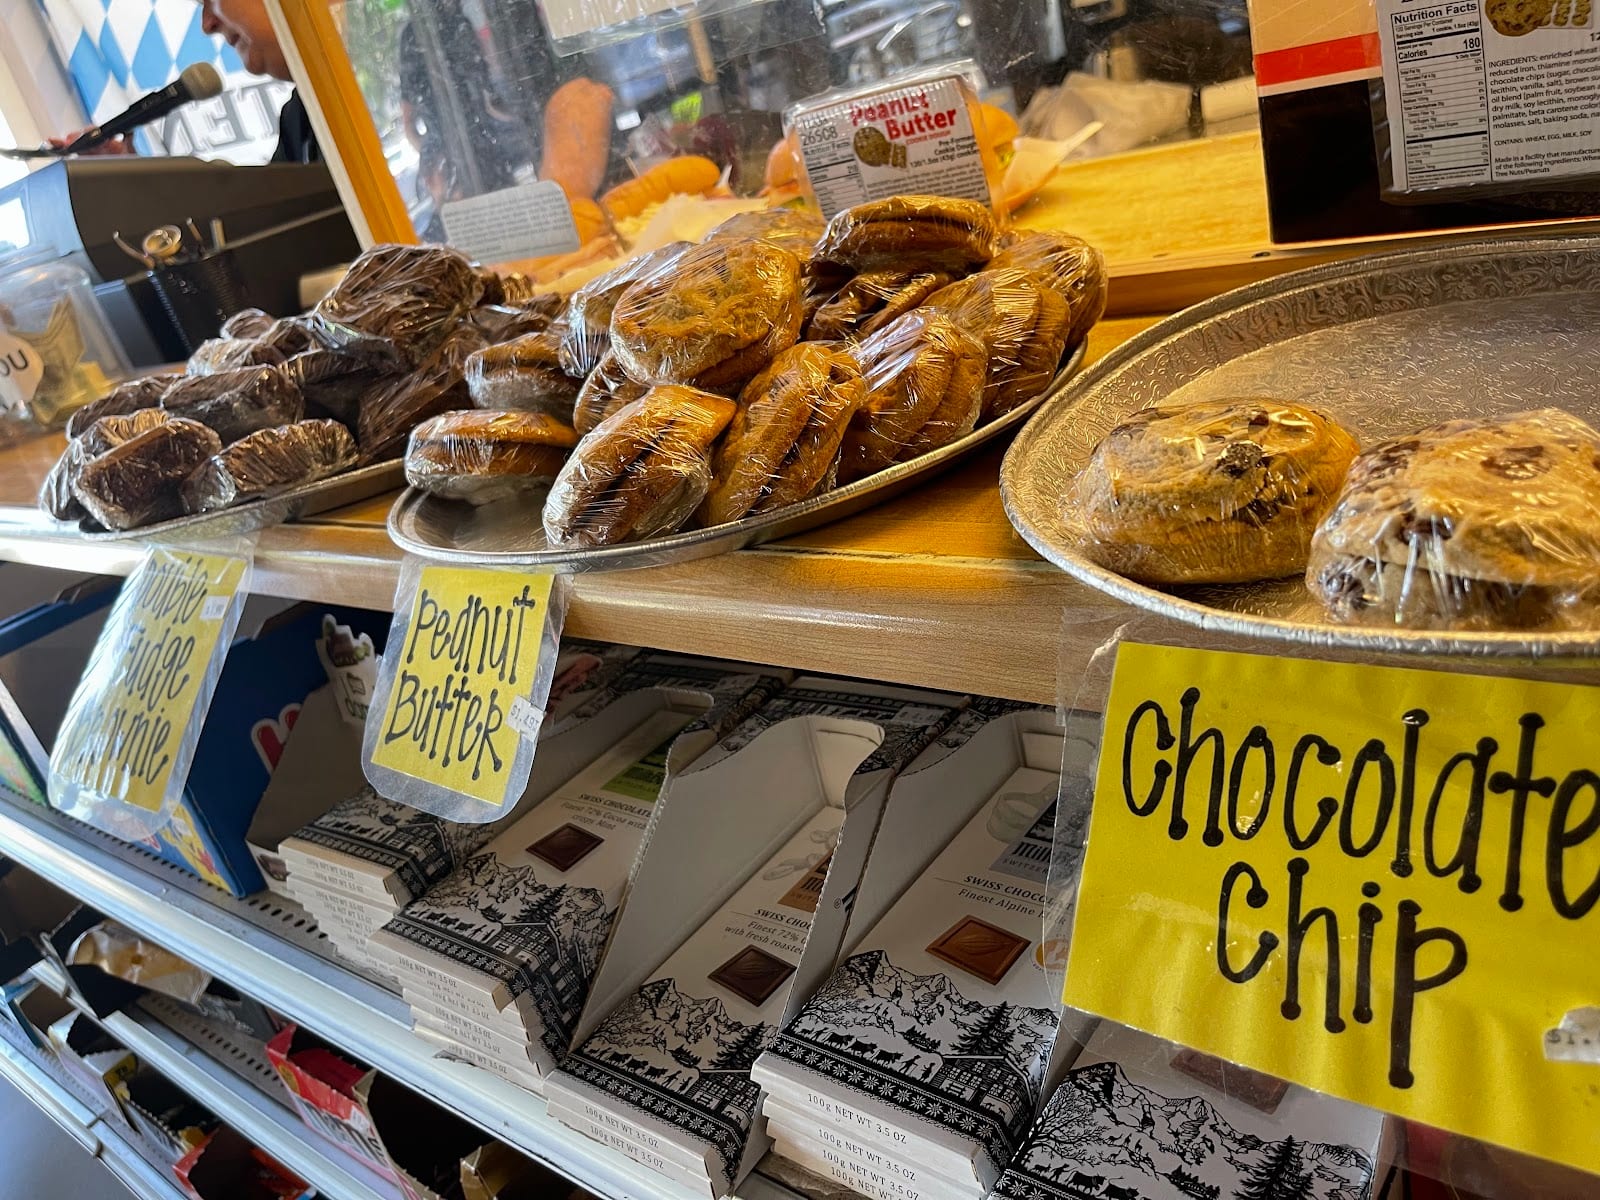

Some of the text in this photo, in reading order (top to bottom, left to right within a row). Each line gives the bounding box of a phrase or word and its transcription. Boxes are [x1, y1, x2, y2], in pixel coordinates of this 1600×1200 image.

[1394, 3, 1477, 24] Nutrition Facts
[1398, 37, 1480, 60] Calories 180
[1489, 55, 1538, 68] INGREDIENTS:
[1540, 49, 1573, 60] enriched
[1490, 67, 1519, 77] reduced
[1490, 76, 1525, 86] chocolate
[1526, 73, 1545, 83] chips
[849, 89, 929, 127] Peanut
[1491, 95, 1500, 104] oil
[1501, 93, 1522, 102] blend
[1491, 104, 1503, 113] dry
[1543, 115, 1568, 123] baking
[1546, 105, 1578, 114] carotene
[886, 108, 957, 140] Butter
[1514, 159, 1543, 169] following
[406, 584, 536, 685] Peanut
[964, 874, 1003, 891] SWISS
[958, 887, 1036, 917] Finest Alpine
[754, 908, 787, 922] SWISS
[724, 925, 744, 937] with
[745, 931, 770, 944] fresh
[748, 920, 777, 935] Finest
[585, 1105, 659, 1149] 100g NET WT 3.5 OZ
[808, 1093, 907, 1145] 100g NET WT 3.5 OZ
[590, 1125, 664, 1169] 100g NET WT 3.5 OZ
[818, 1128, 916, 1181] 100g NET WT 3.5 OZ
[823, 1149, 846, 1169] 100g
[849, 1161, 868, 1177] NET
[870, 1171, 887, 1186] WT
[890, 1180, 904, 1194] 3.5
[831, 1166, 854, 1186] 100g
[858, 1179, 877, 1194] NET
